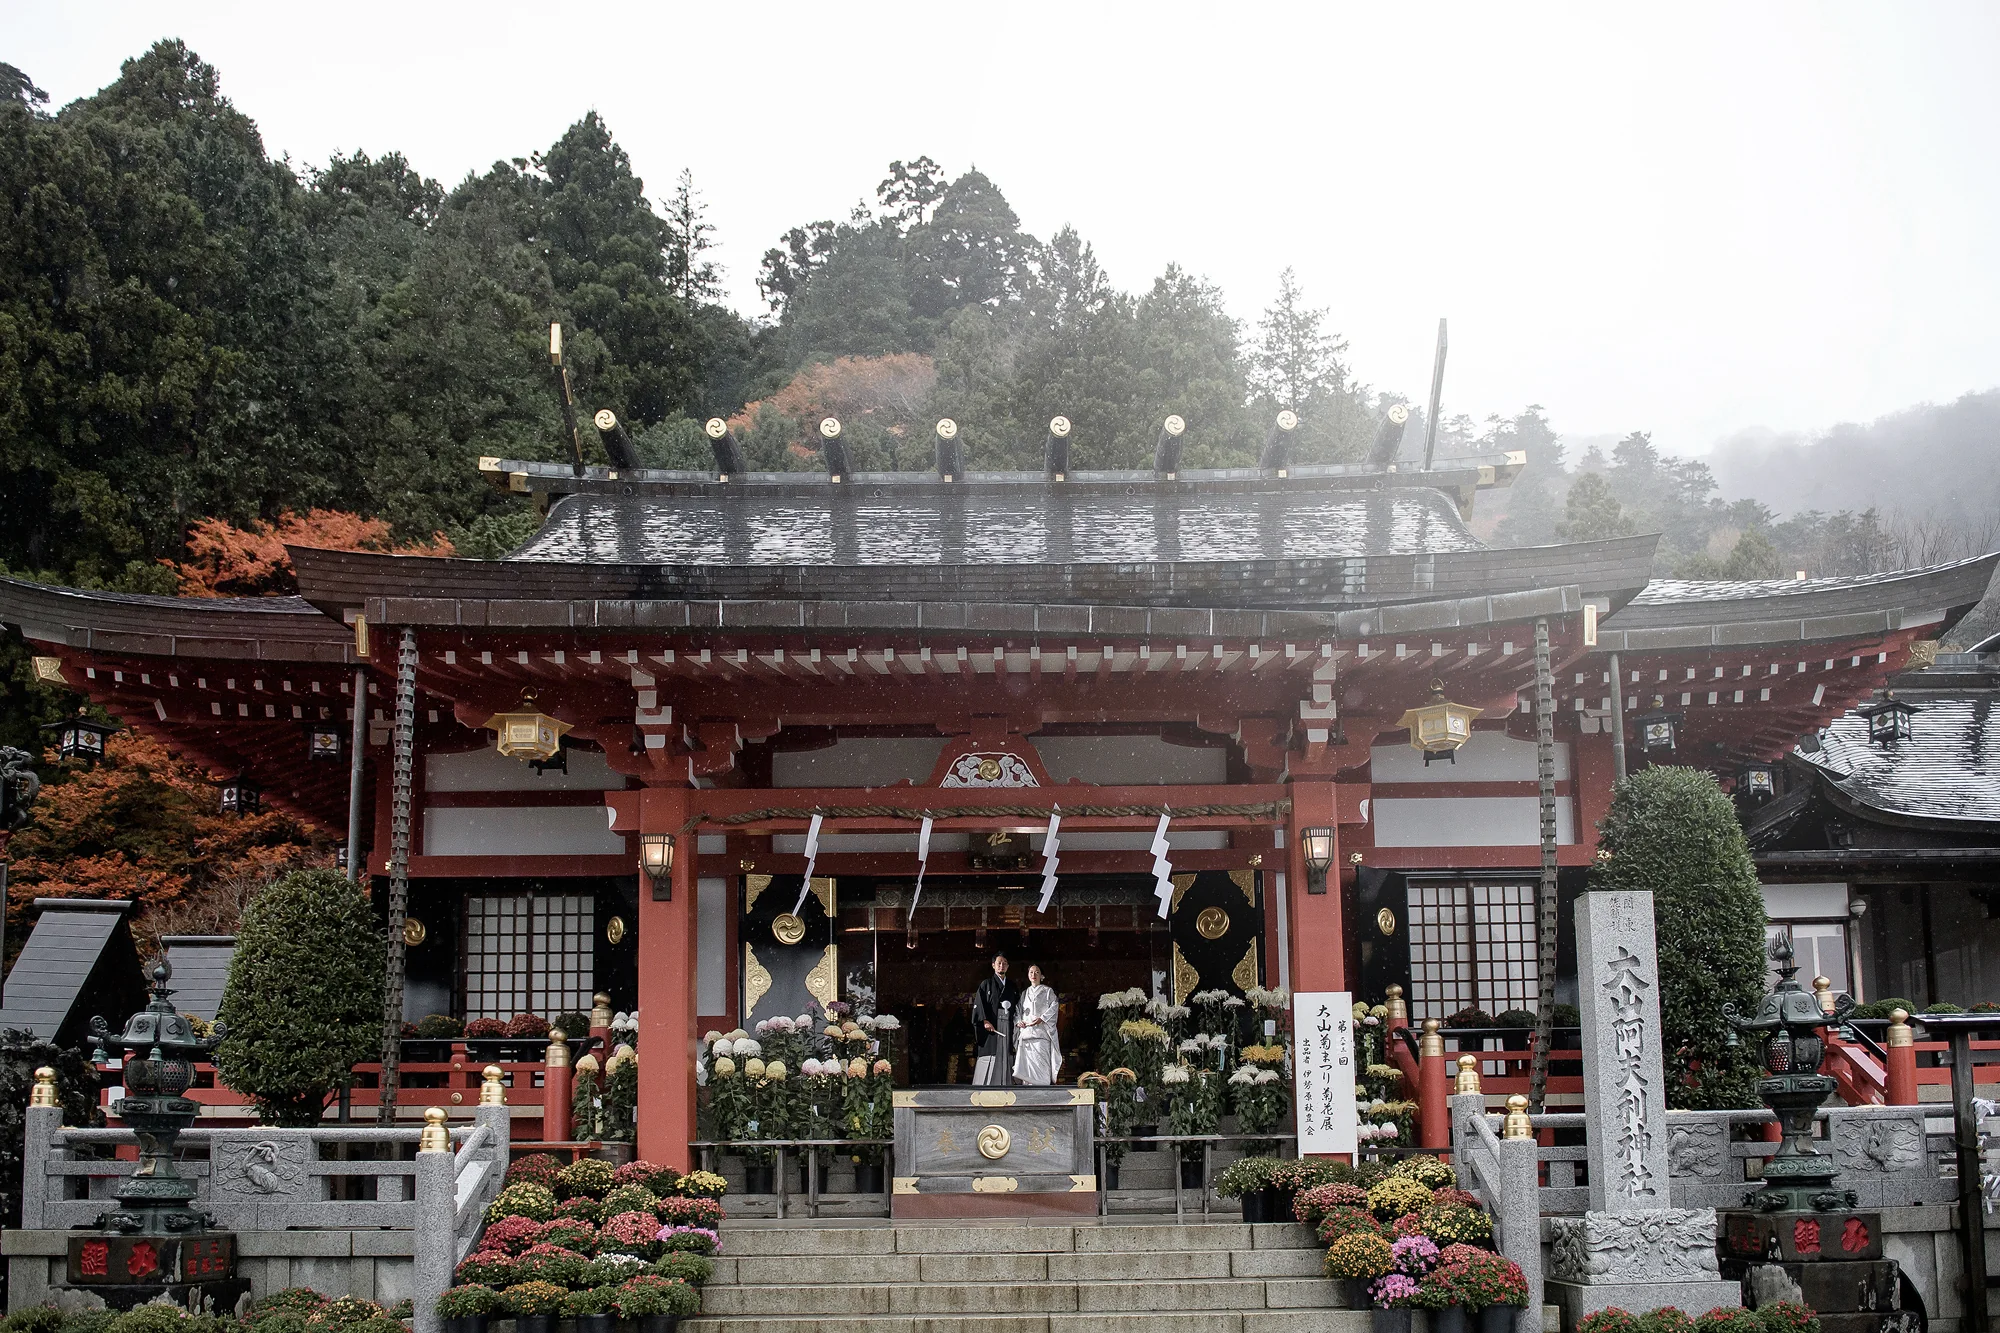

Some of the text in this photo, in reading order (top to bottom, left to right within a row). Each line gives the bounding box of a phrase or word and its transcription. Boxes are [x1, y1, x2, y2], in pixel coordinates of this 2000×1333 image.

[1316, 1004, 1334, 1131] 大山菊まつり菊花展
[1602, 946, 1656, 1199] 大山阿夫利神社
